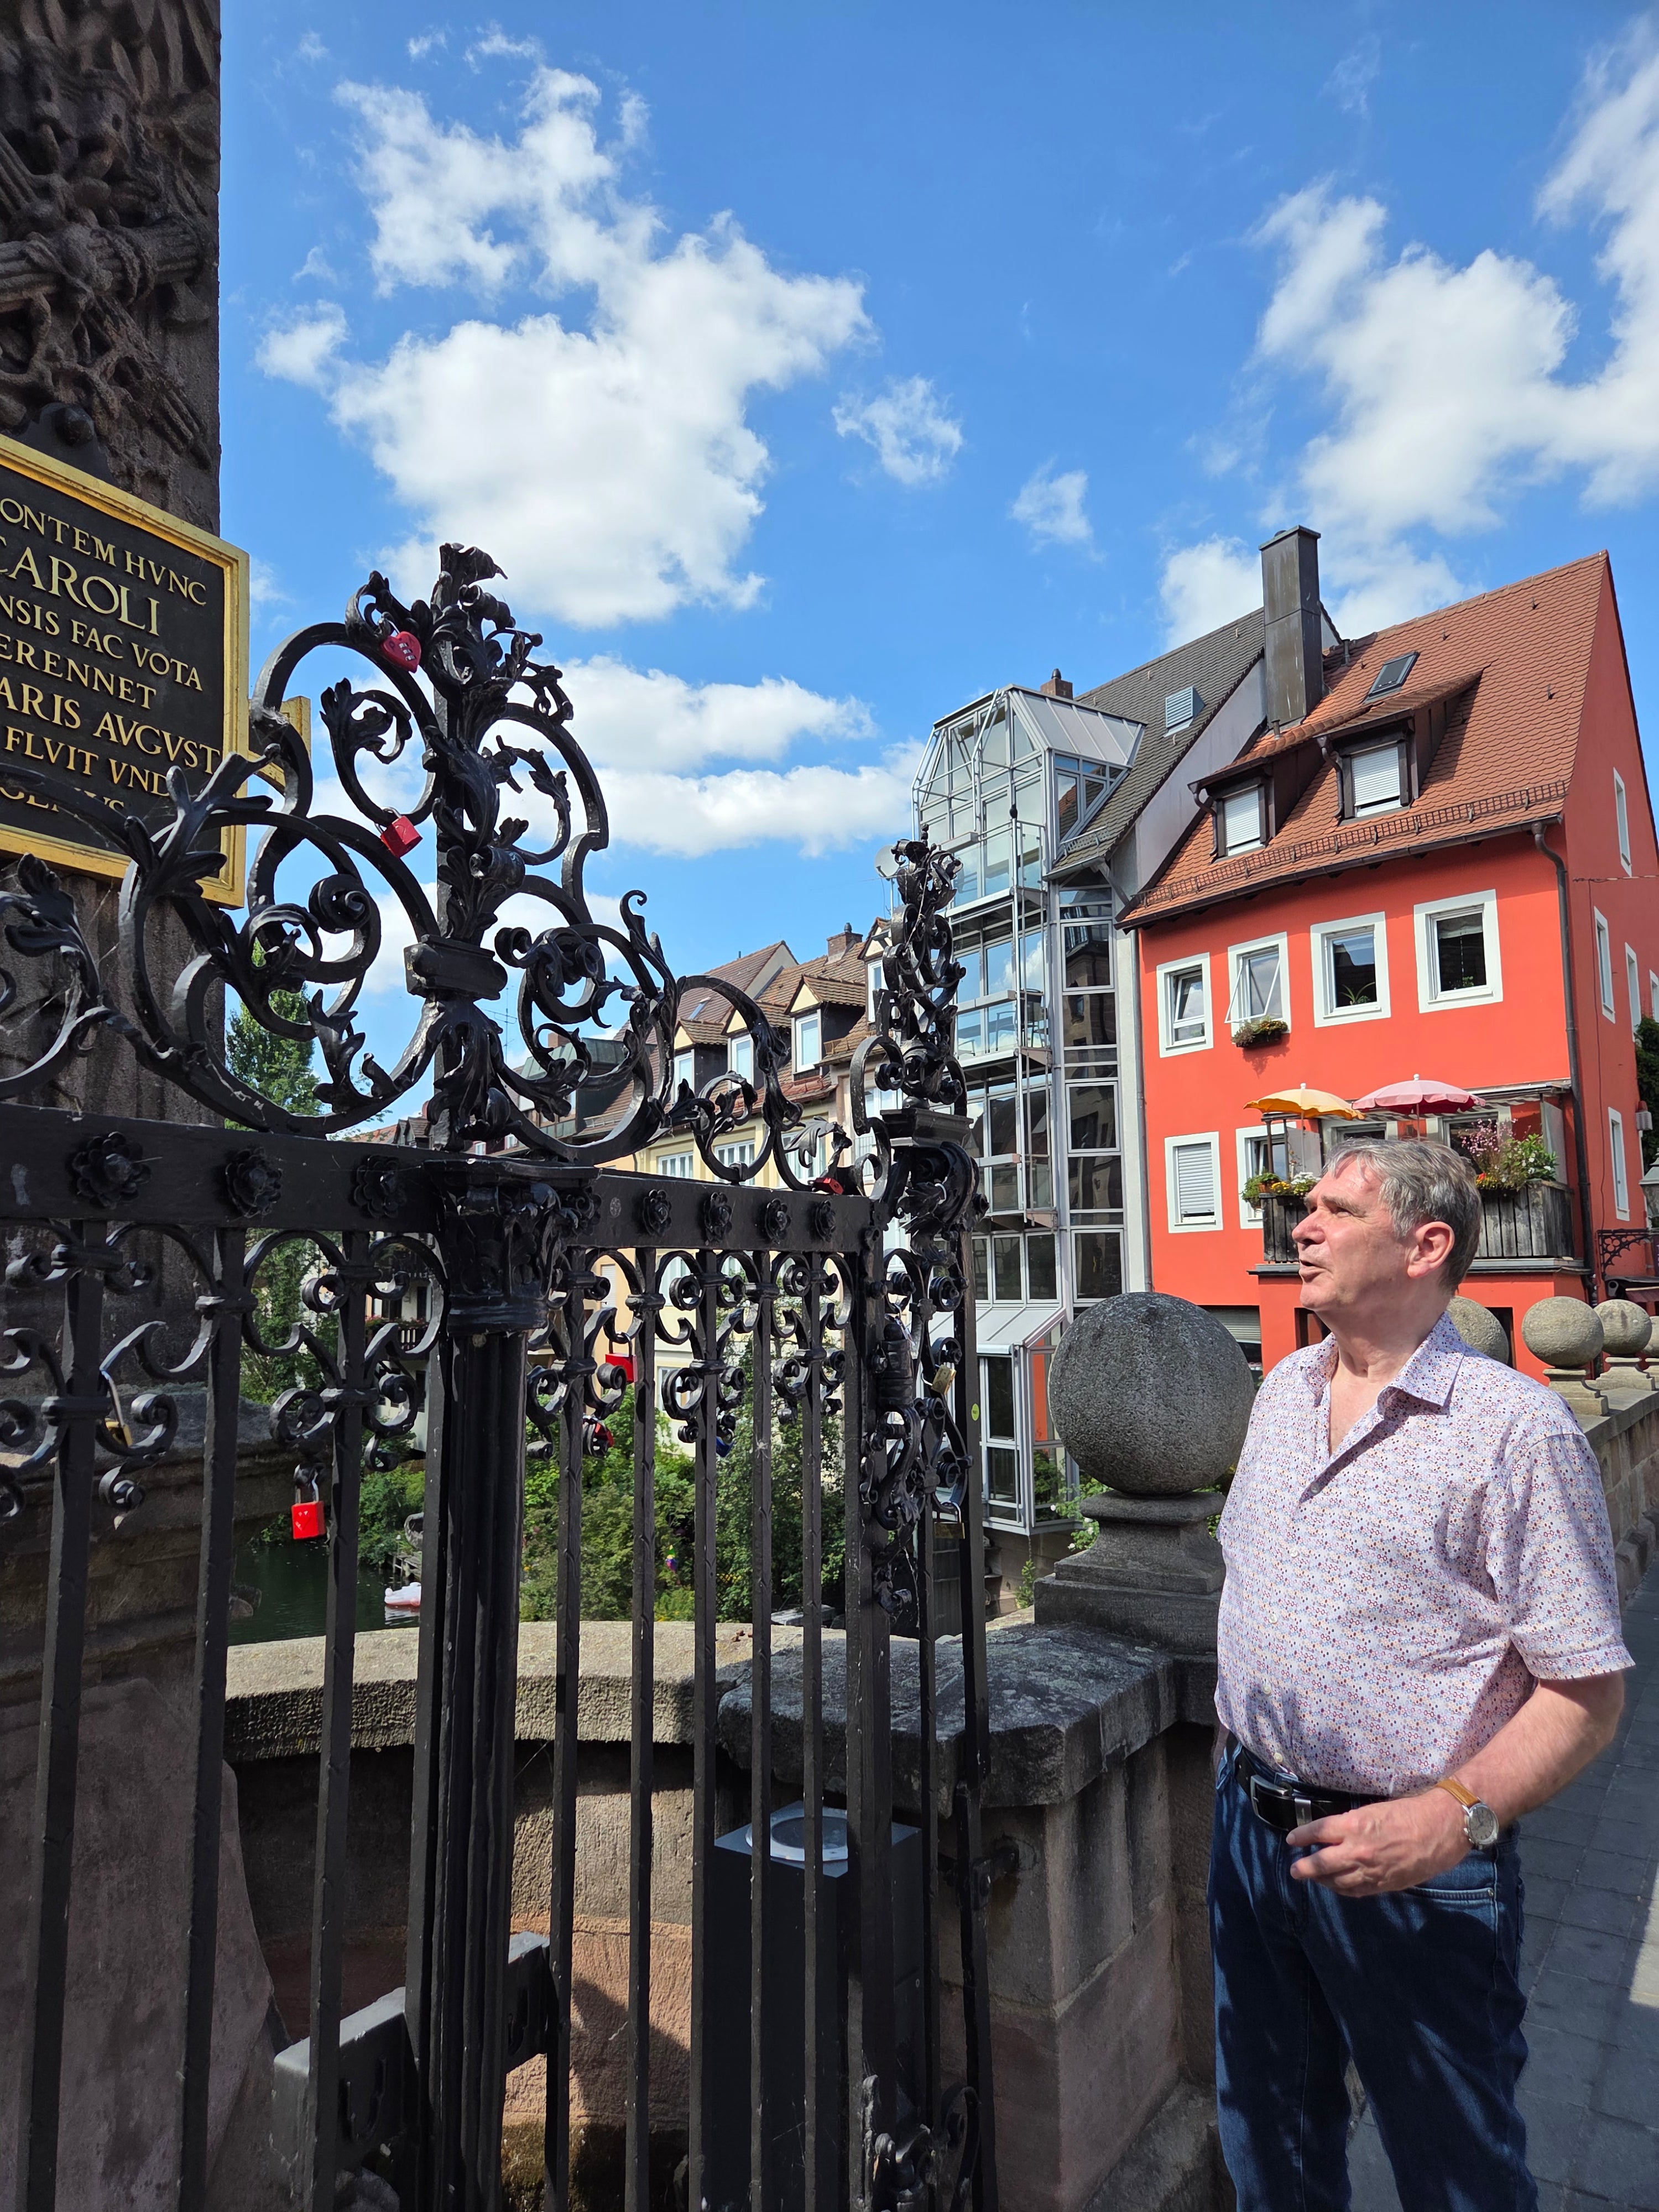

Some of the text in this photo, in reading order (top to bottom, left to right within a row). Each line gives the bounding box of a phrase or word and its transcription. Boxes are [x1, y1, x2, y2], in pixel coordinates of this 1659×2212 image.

[0, 498, 206, 606] ONTEM HVNC
[0, 535, 160, 636] AROLI
[71, 619, 123, 659] FAC
[132, 643, 202, 691] VOTA
[0, 677, 221, 774] ARIS AVGVST
[4, 726, 99, 775] FLVIT
